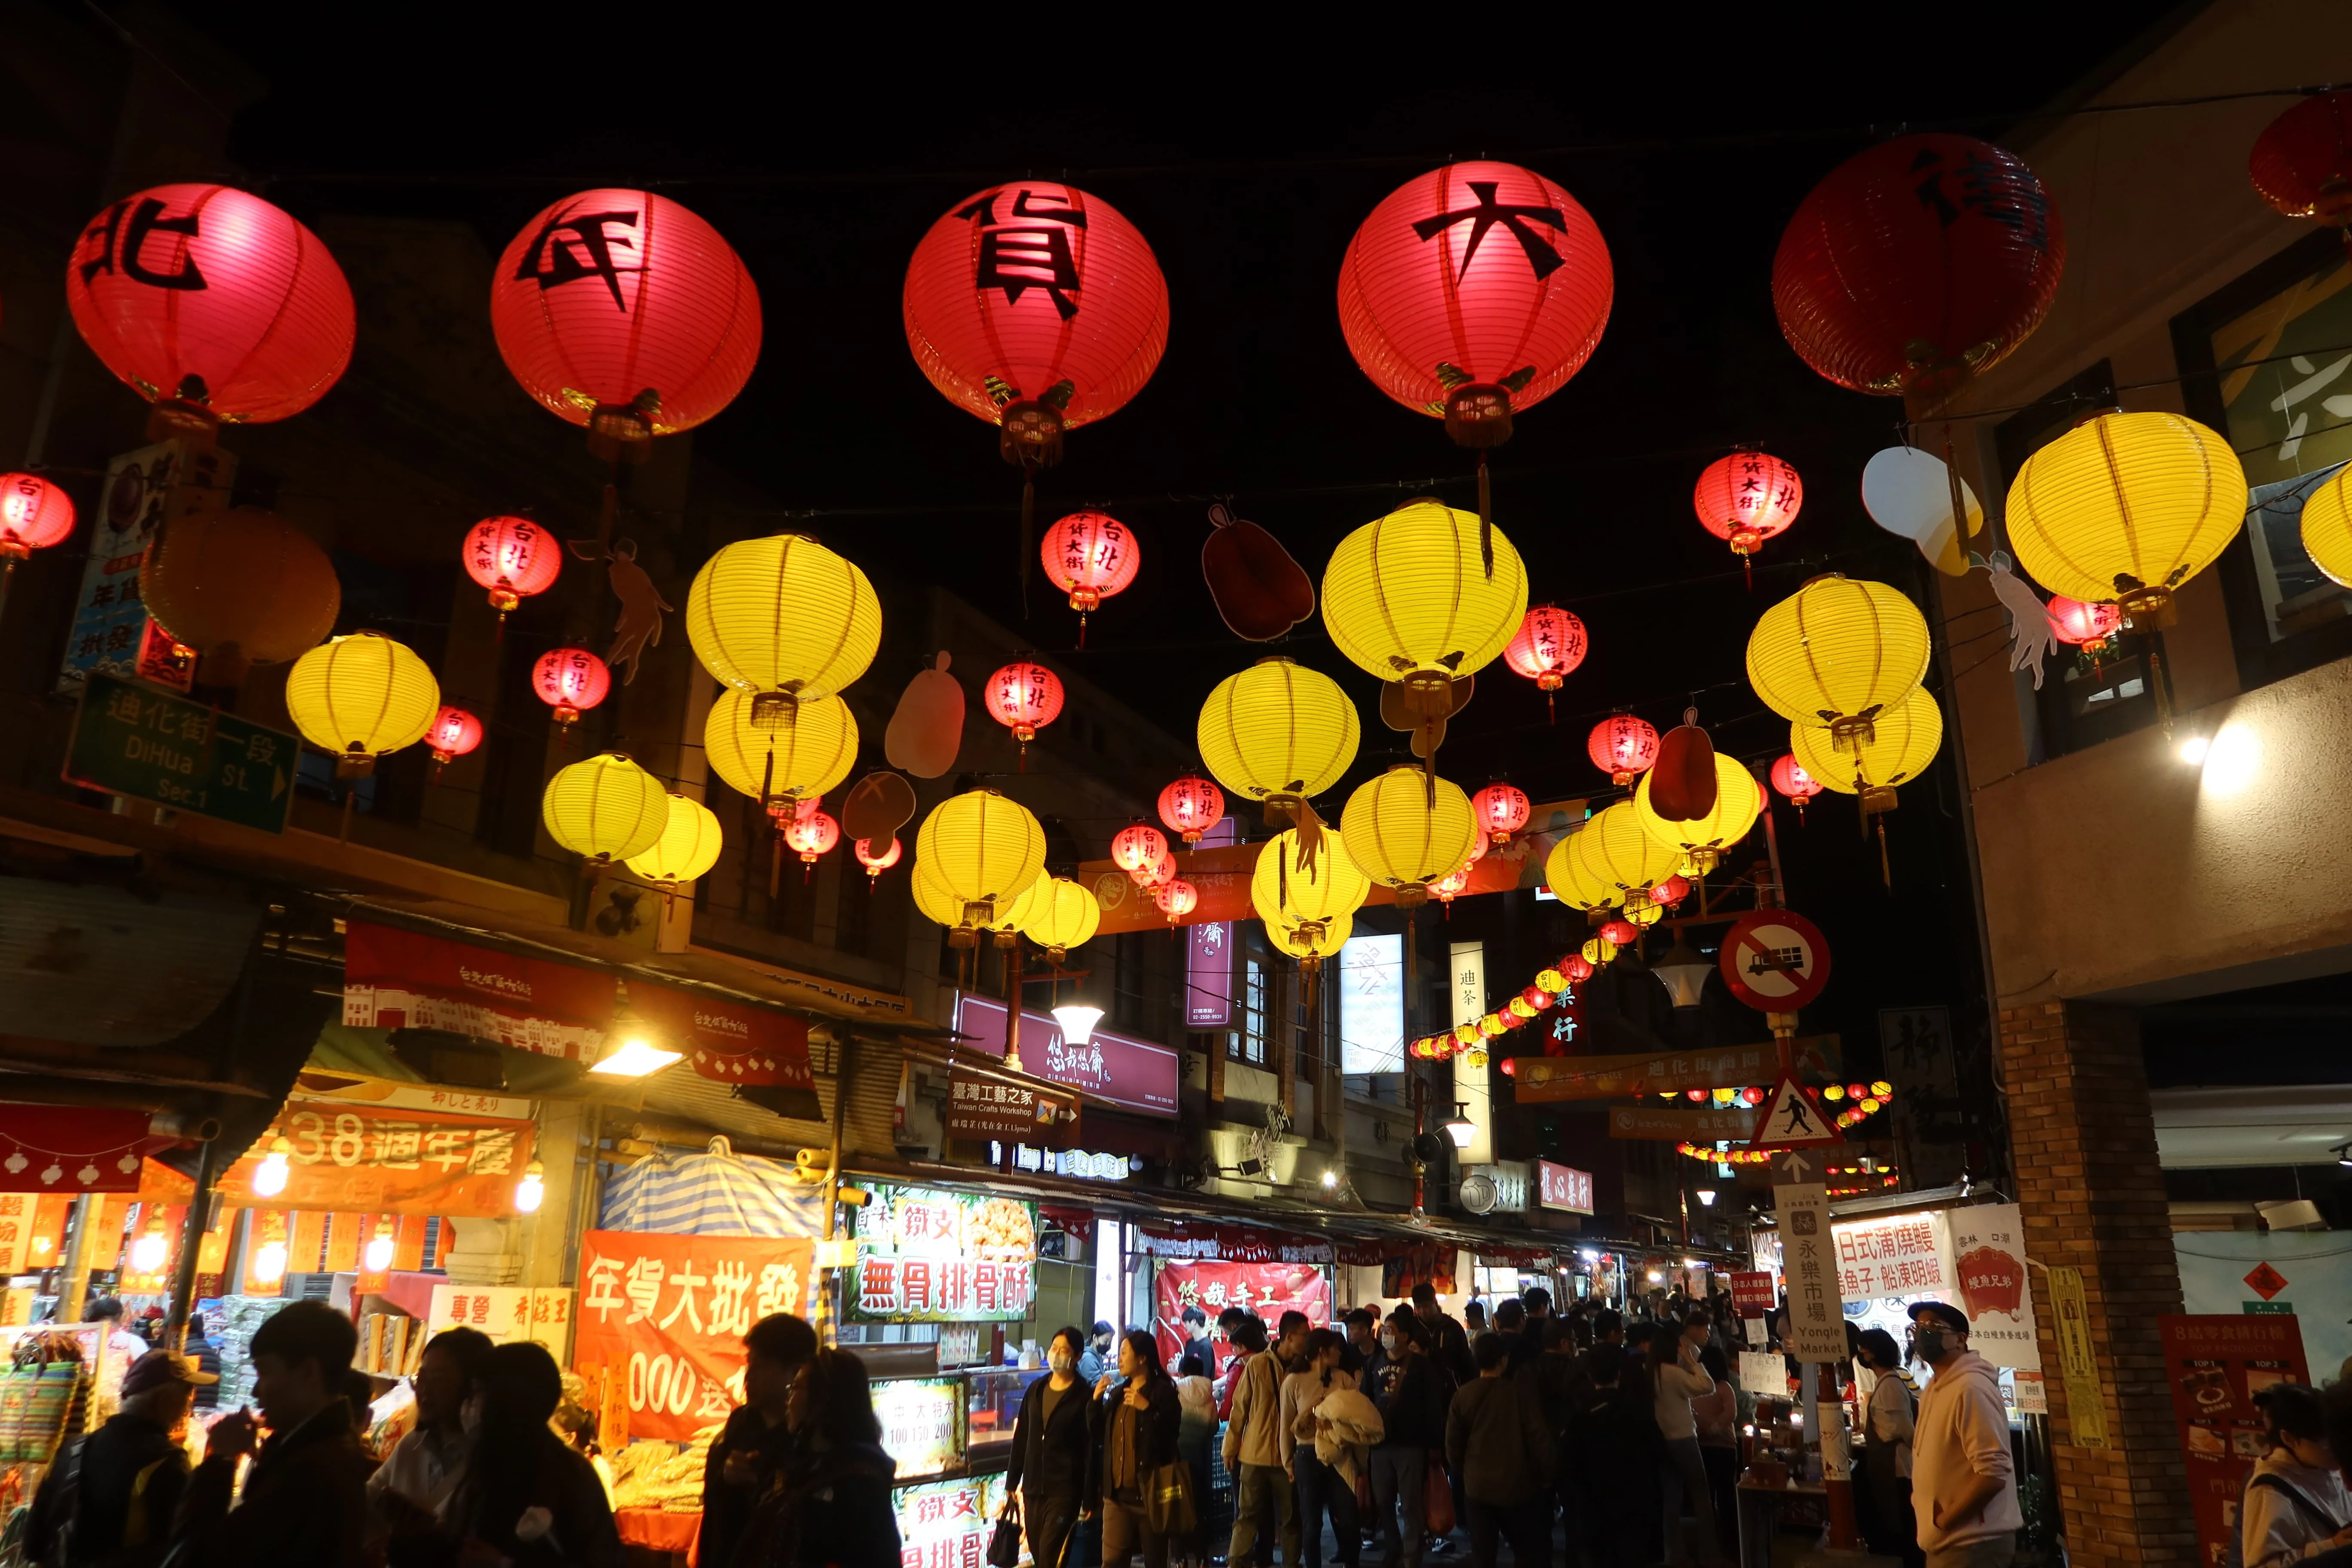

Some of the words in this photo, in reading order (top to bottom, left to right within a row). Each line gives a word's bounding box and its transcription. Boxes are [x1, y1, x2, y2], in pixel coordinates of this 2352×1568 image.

[80, 197, 208, 290] 北
[1411, 181, 1569, 287] 大
[514, 198, 651, 313] 年
[951, 190, 1087, 322] 貨
[1775, 462, 1798, 513] 台北
[506, 523, 536, 570] 台北
[1095, 521, 1123, 571] 台北
[1565, 612, 1583, 656] 台北
[569, 653, 589, 692] 台北
[1027, 668, 1047, 708] 台北
[106, 689, 277, 766] 迪化街一段
[1639, 722, 1654, 759] 台北
[125, 735, 193, 775] DiHua
[222, 764, 249, 792] St
[1199, 782, 1213, 817] 台北
[1513, 790, 1525, 821] 台北
[1144, 830, 1155, 859] 台北
[1175, 885, 1186, 906] 台北
[1585, 943, 1594, 958] 台北
[1460, 969, 1476, 1006] 迪茶
[1540, 973, 1550, 989] 台北
[952, 1081, 1033, 1106] 臺灣工藝之家
[953, 1102, 977, 1111] Taiwan
[978, 1104, 998, 1113] Crafts
[1000, 1106, 1032, 1118] Workshop
[290, 1111, 516, 1178] 38週年慶
[1017, 1142, 1041, 1173] Mango
[1044, 1146, 1057, 1172] ice
[1065, 1152, 1128, 1176] 芒果雪花冰
[904, 1202, 957, 1240] 鐵支
[1838, 1220, 1935, 1264] 日式蒲燒鰻
[1958, 1233, 1978, 1247] 雲林
[1991, 1232, 2010, 1244] 口湖
[585, 1252, 801, 1336] 年貨大批發
[862, 1257, 1030, 1311] 無骨排骨酥
[1178, 1279, 1282, 1311] 悠哉手工
[1798, 1239, 1827, 1323] 永樂市場
[1967, 1273, 2012, 1289] 鰻魚兄弟
[450, 1295, 490, 1325] 專營
[514, 1296, 567, 1326] 香菇王
[1798, 1326, 1841, 1338] Yongle
[1800, 1341, 1843, 1355] Market
[2191, 1344, 2213, 1353] TOP
[894, 1405, 905, 1420] 中
[916, 1404, 926, 1419] 大
[932, 1400, 955, 1418] 特大
[891, 1427, 907, 1444] 100
[912, 1425, 929, 1442] 150
[935, 1422, 952, 1439] 200
[917, 1488, 980, 1524] 鐵支
